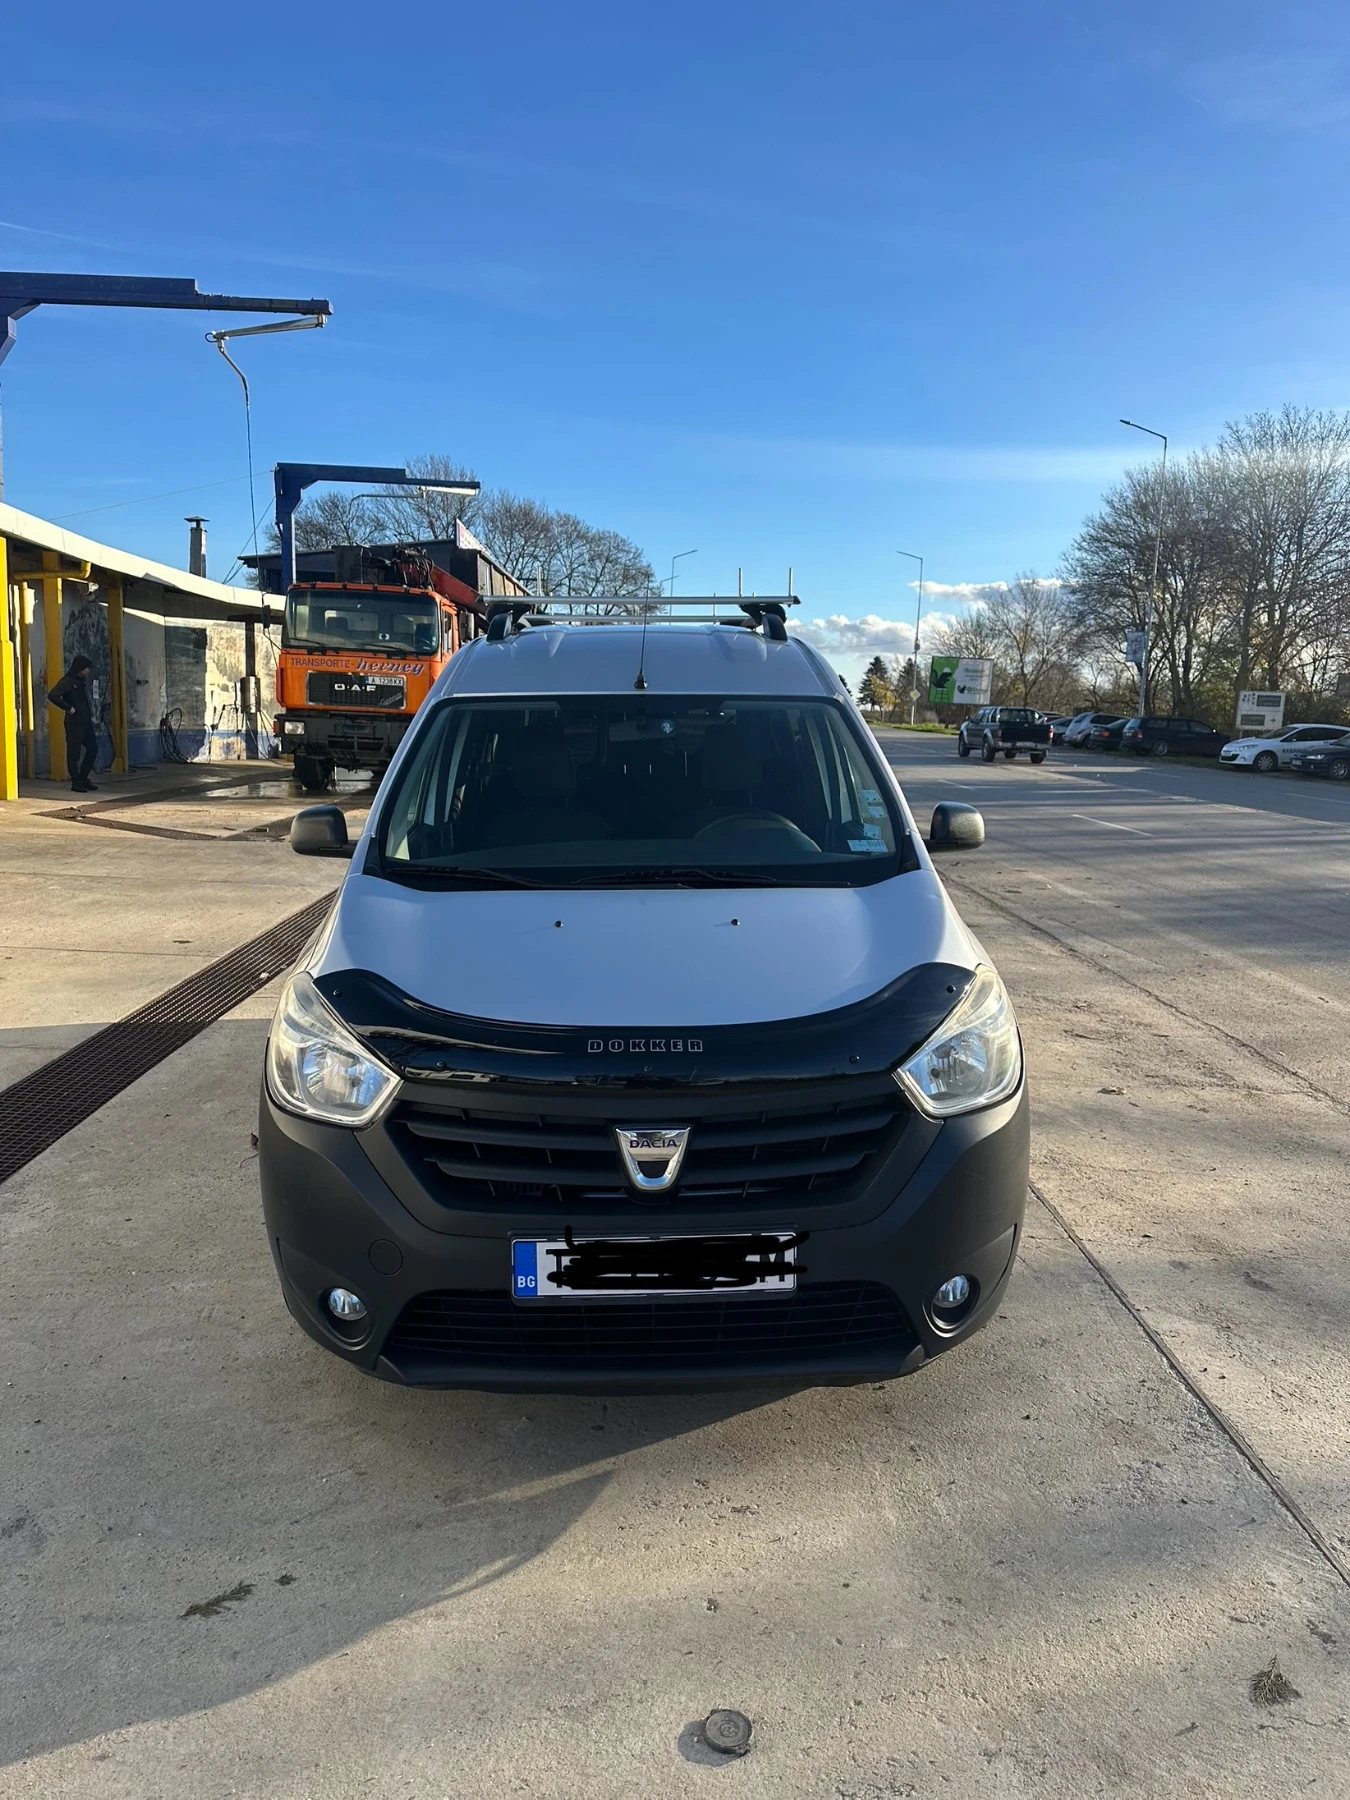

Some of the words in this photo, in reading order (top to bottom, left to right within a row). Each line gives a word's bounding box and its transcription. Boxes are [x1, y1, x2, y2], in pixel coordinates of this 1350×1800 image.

[587, 1039, 704, 1053] DOKKER
[629, 1139, 678, 1149] DACIA
[516, 1275, 536, 1288] BG
